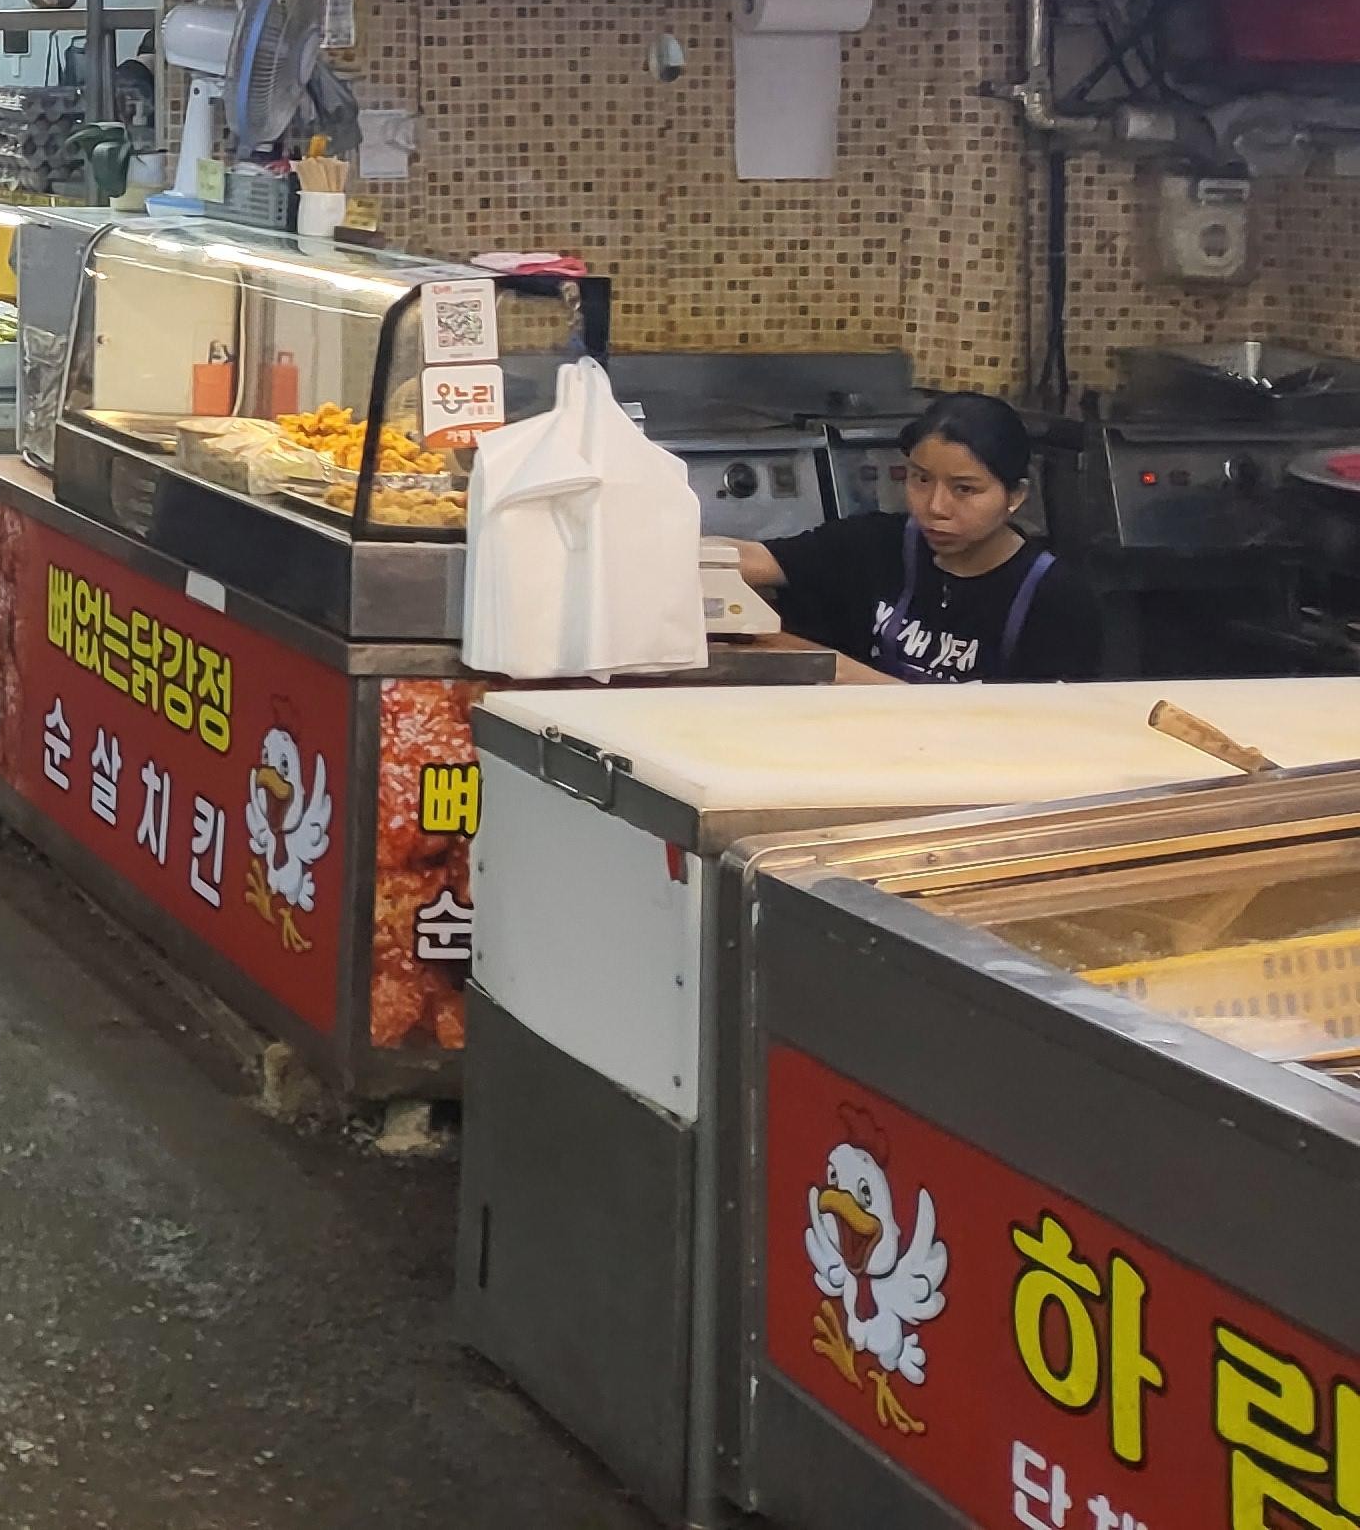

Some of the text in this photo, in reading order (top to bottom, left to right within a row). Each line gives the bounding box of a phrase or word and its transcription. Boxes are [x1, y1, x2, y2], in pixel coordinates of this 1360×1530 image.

[48, 562, 233, 755] 뼈없는닭강정
[42, 697, 226, 909] 순살치킨
[416, 888, 473, 960] 순
